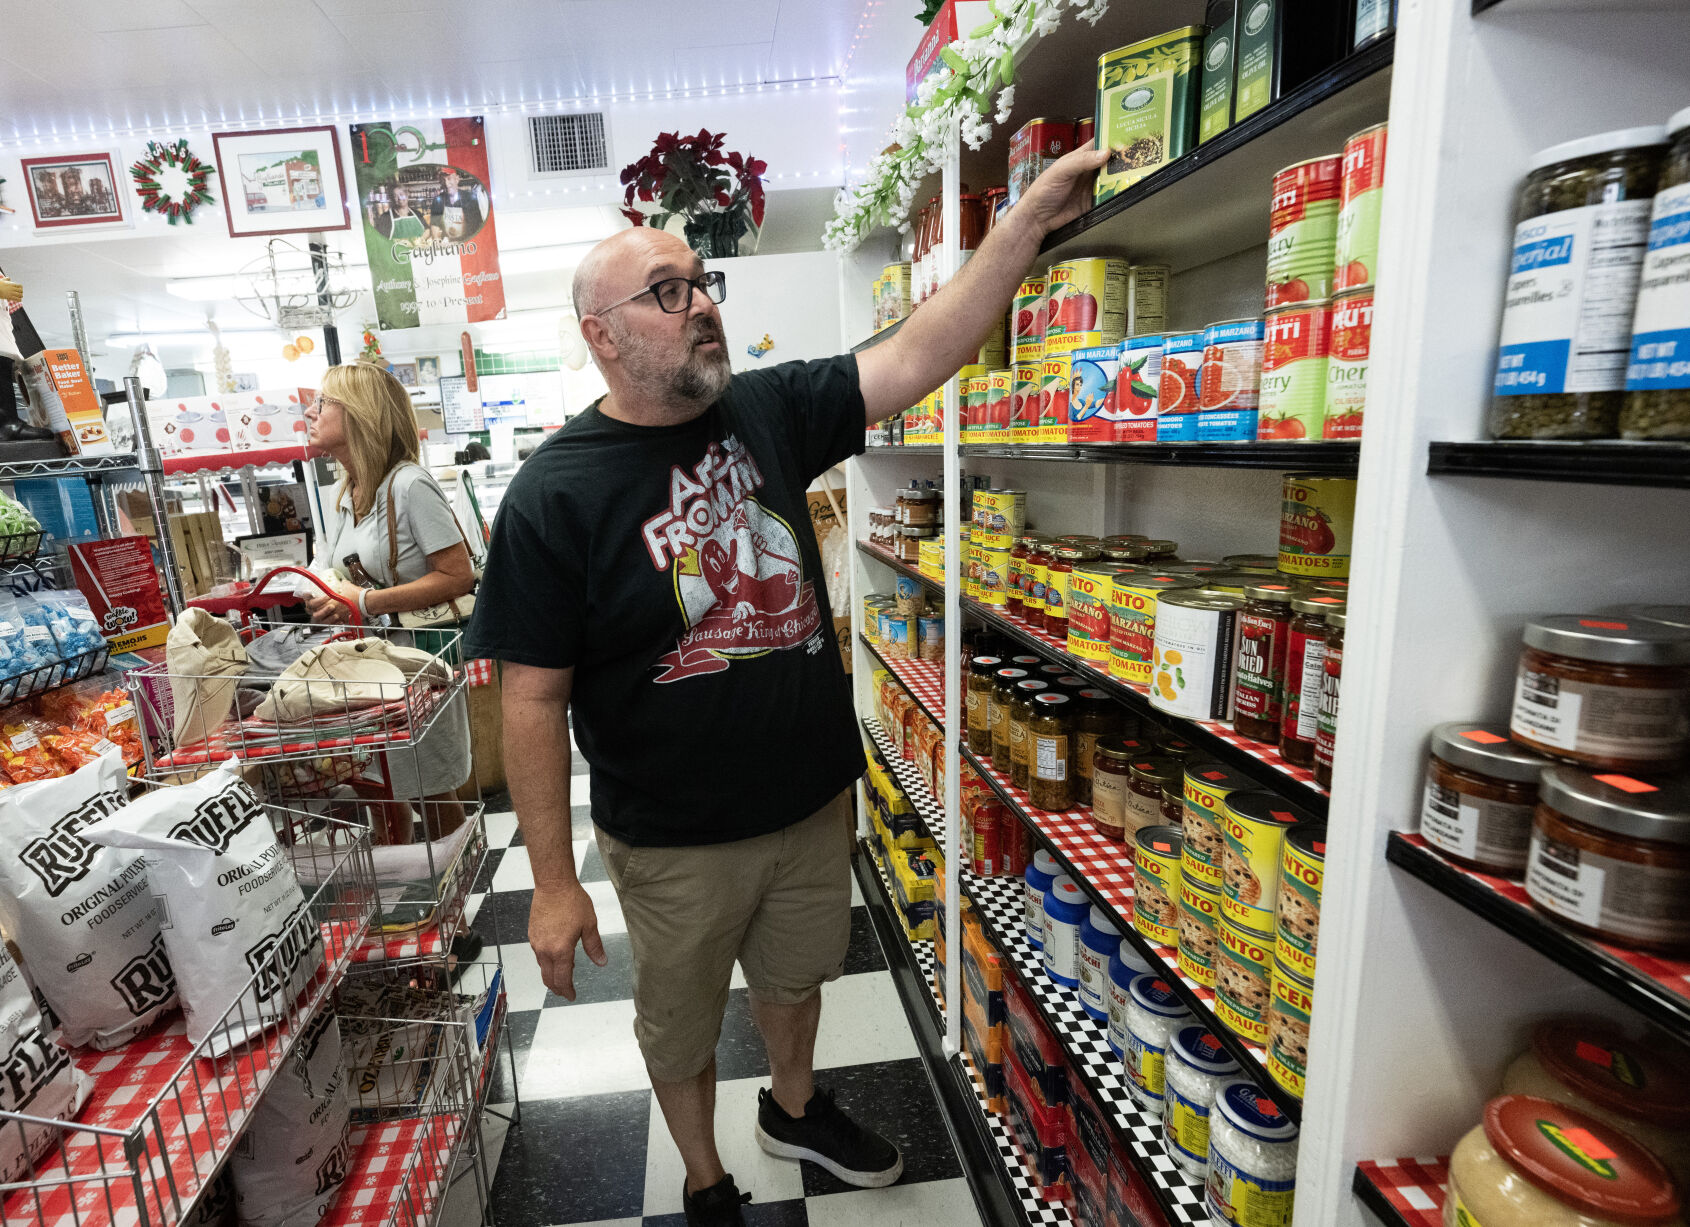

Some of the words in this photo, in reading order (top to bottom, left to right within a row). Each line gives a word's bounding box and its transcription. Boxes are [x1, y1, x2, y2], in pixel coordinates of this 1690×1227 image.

[117, 635, 147, 648] EMOJIS
[682, 619, 743, 646] Sausage
[743, 617, 774, 641] King
[61, 879, 123, 926] ORIGINAL
[87, 878, 149, 930] FOODSERVICE
